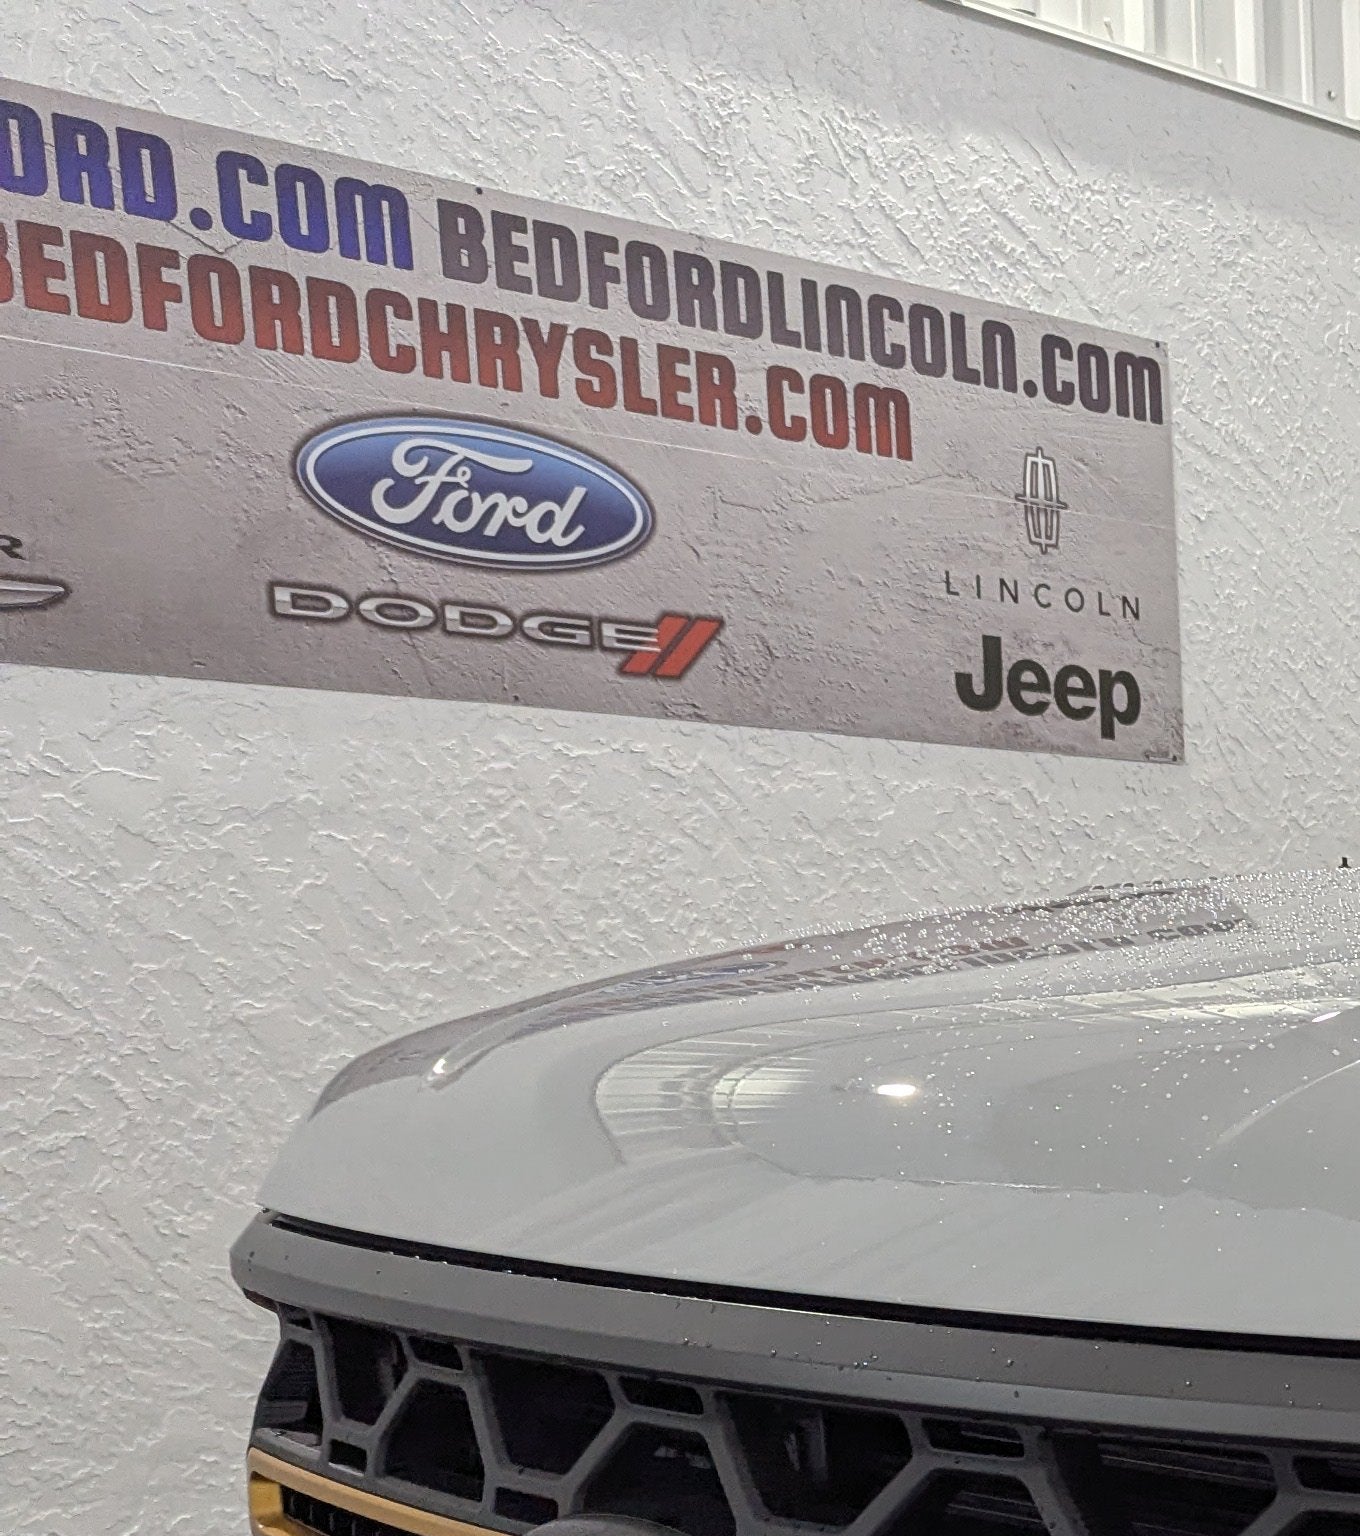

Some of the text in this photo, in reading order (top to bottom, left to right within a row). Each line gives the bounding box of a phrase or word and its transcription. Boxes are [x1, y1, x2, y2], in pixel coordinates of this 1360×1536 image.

[0, 219, 913, 462] EDFORDCHRYSLER.COM
[436, 198, 1164, 425] BEDFORDLINCOLN.COM
[371, 437, 587, 550] Ford
[273, 585, 662, 654] DODGE
[944, 569, 1141, 622] LINCOLN
[954, 633, 1142, 741] Jeep
